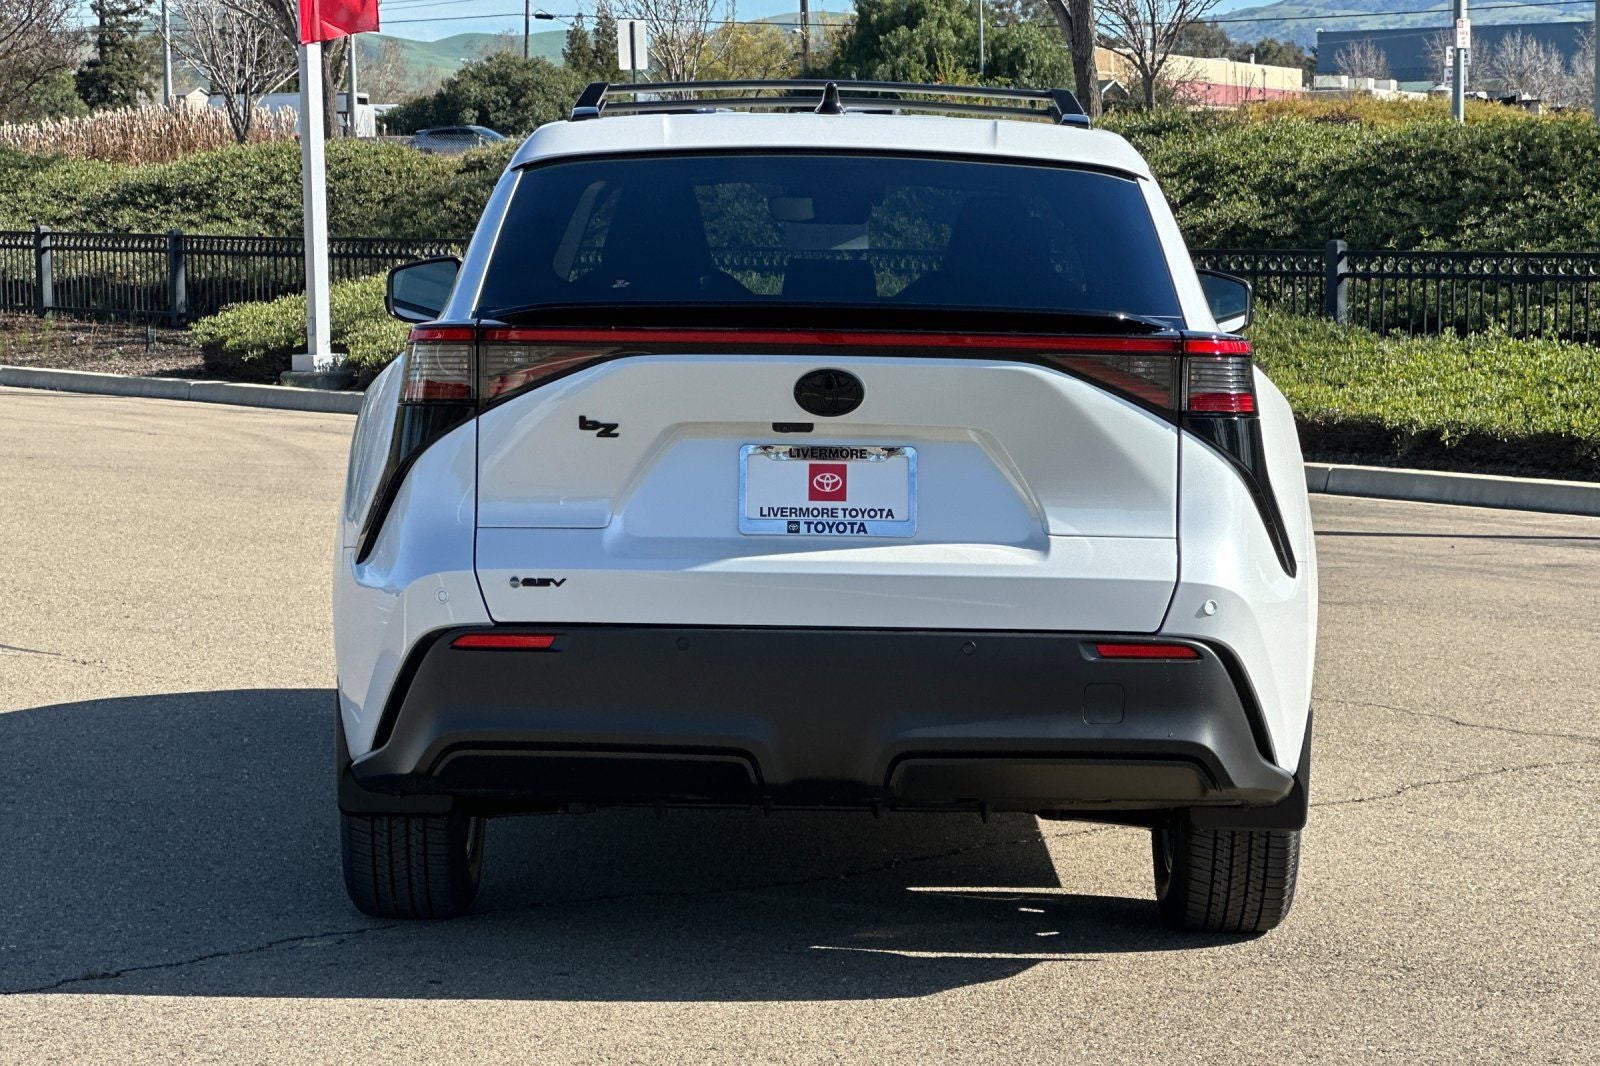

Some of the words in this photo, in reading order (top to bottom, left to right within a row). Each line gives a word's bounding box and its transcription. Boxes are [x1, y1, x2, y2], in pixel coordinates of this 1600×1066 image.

[789, 447, 868, 460] LIVERMORE
[759, 506, 839, 519] LIVERMORE
[841, 507, 895, 520] TOYOTA
[804, 521, 868, 535] TOYOTA
